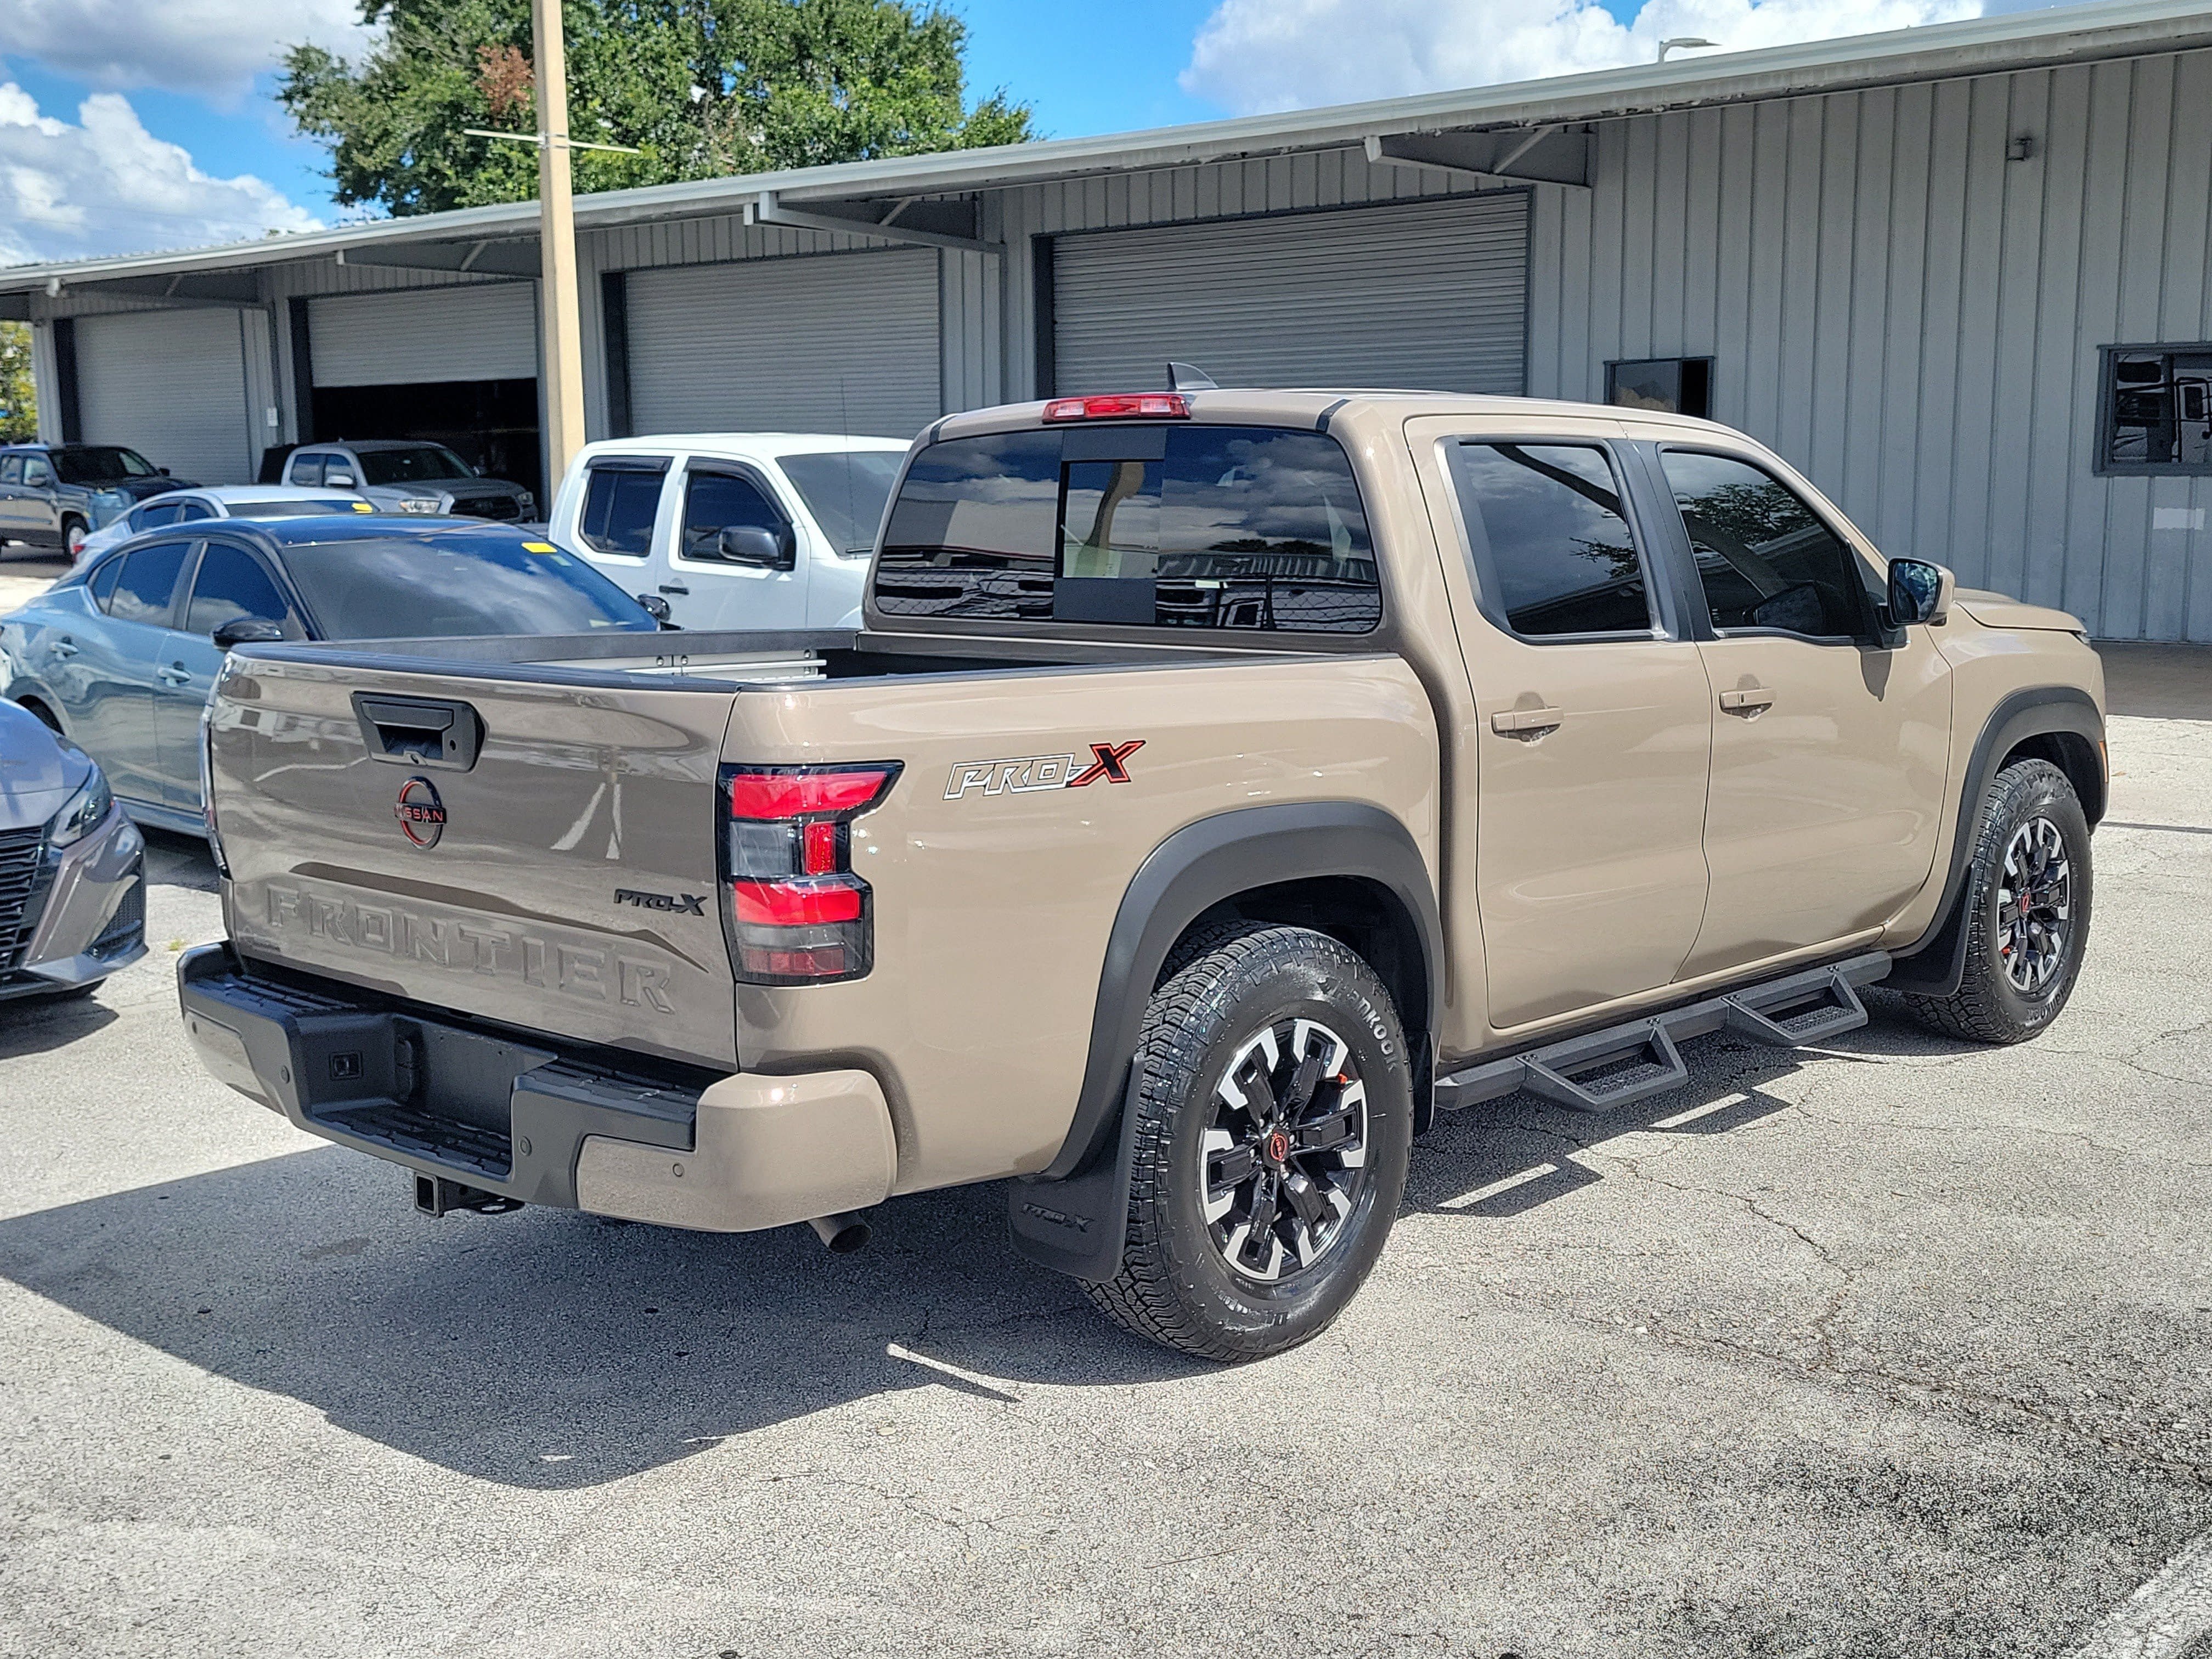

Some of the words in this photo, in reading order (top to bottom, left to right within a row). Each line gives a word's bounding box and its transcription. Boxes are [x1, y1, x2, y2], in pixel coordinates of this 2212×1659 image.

[943, 740, 1146, 800] PRO-X
[613, 889, 708, 916] PRO-X
[267, 884, 676, 1015] FRONTIER
